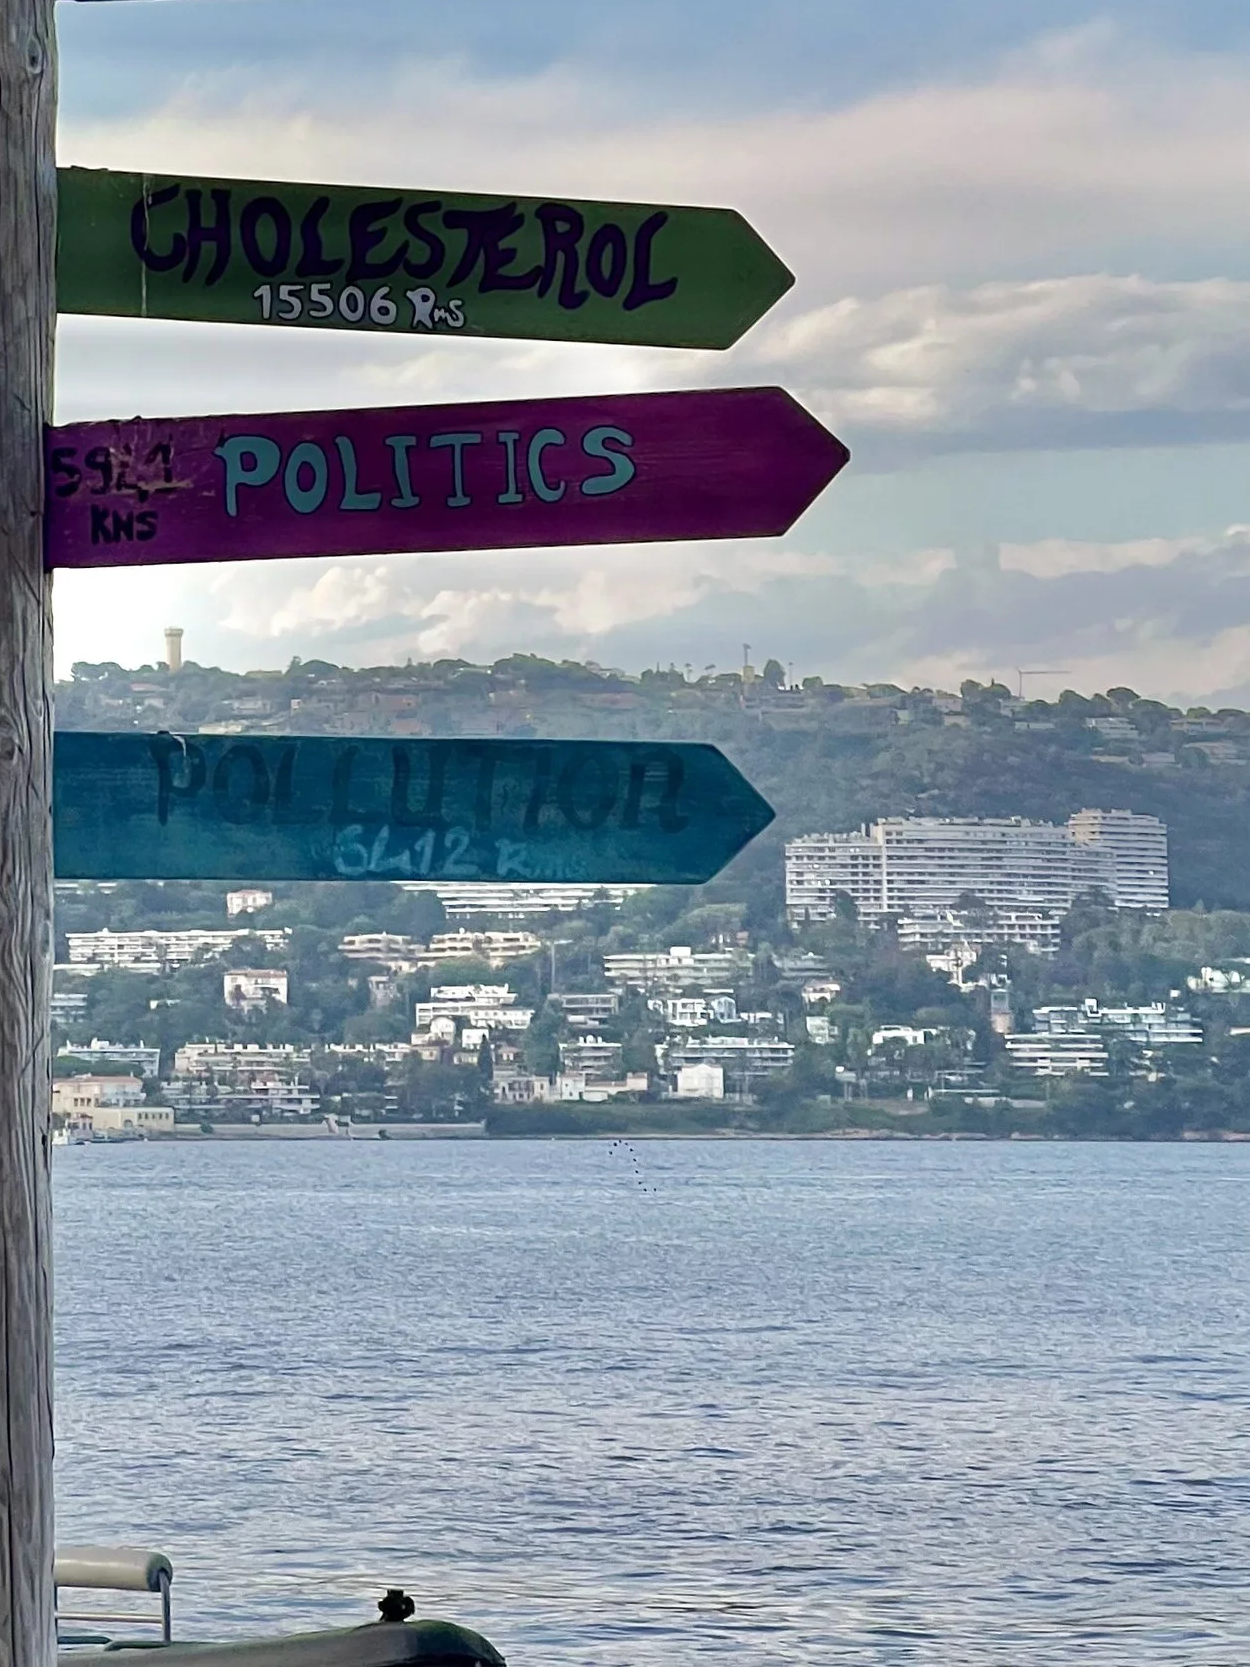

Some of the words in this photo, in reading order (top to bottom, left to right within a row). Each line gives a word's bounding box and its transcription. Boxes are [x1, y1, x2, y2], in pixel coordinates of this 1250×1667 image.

[130, 182, 680, 312] CHOLESTEROL
[252, 282, 398, 326] 15506
[214, 424, 636, 518] POLITICS
